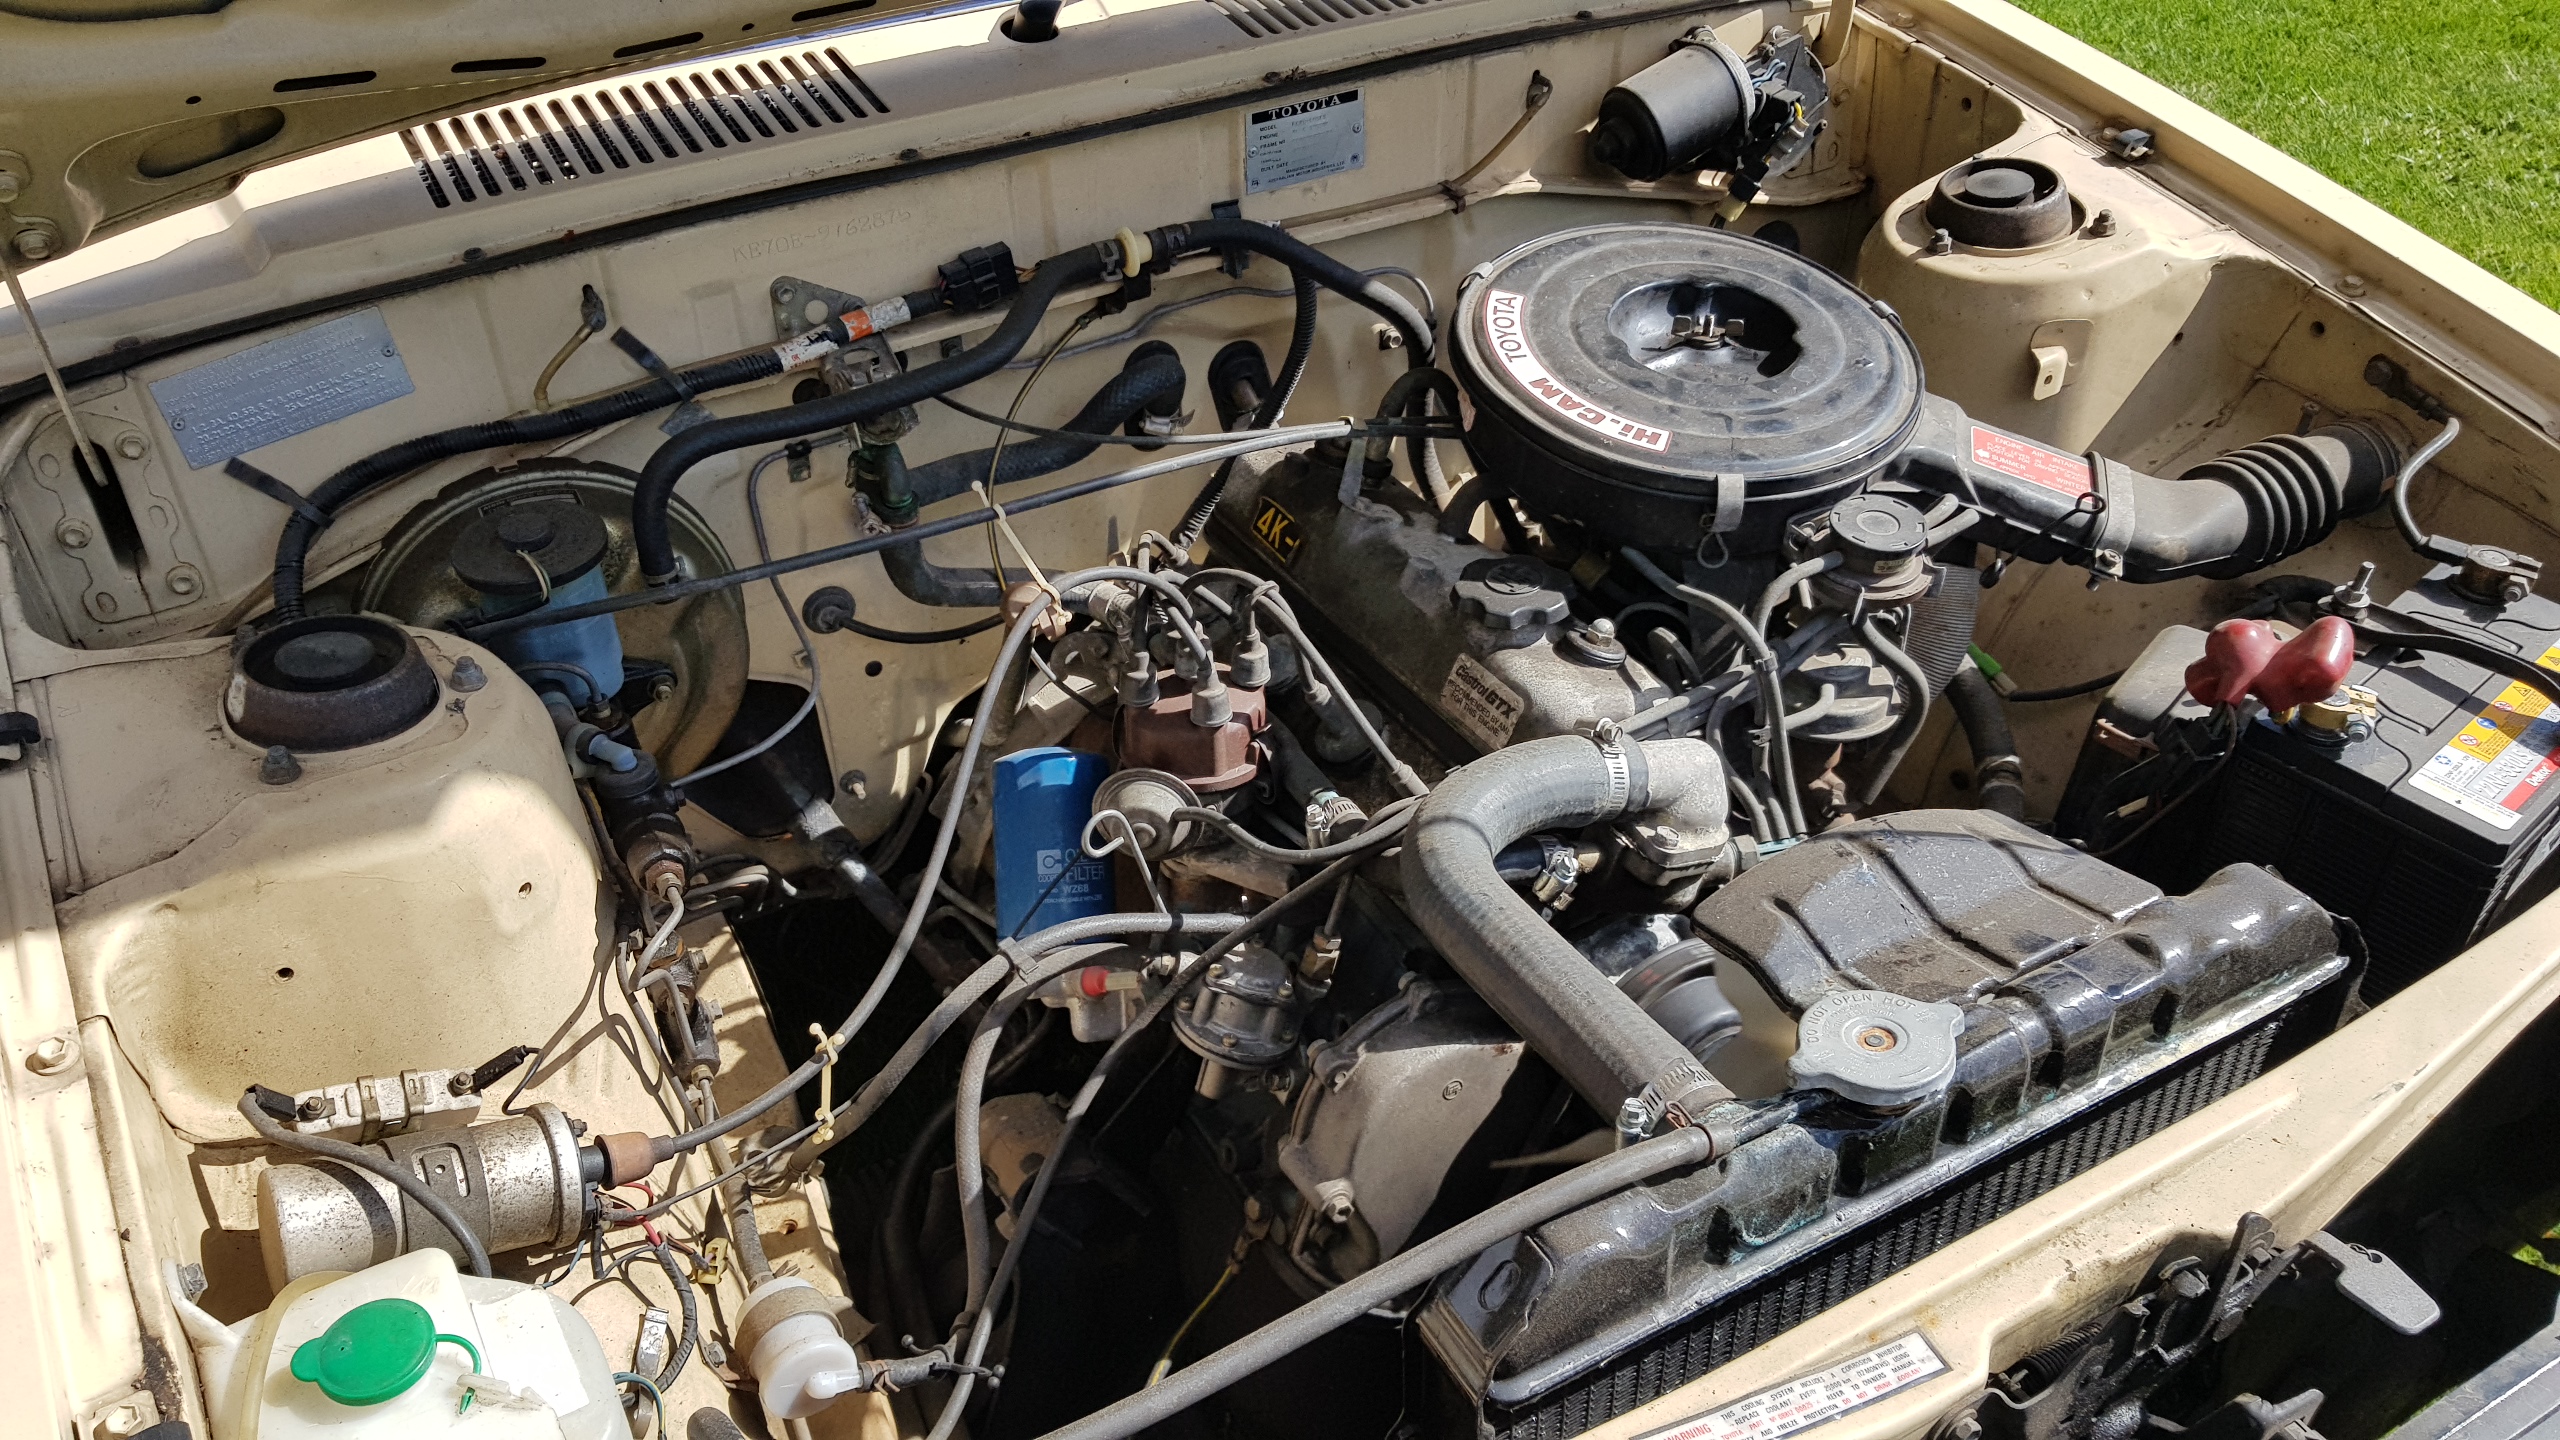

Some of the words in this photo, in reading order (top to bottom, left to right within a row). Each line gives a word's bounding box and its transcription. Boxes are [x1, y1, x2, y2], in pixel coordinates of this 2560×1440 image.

[1269, 95, 1341, 120] TOYOTA
[1492, 296, 1527, 363] TOYOTA
[1991, 454, 2025, 470] SUMMER
[2056, 476, 2085, 491] WINTER
[1995, 436, 2023, 451] ENGINE
[2032, 449, 2044, 458] AIR
[2052, 456, 2078, 470] INTAKE
[1447, 678, 1490, 718] RECOMMENDED
[1490, 714, 1498, 725] BY
[1456, 664, 1488, 698] Castrol
[1486, 688, 1517, 722] GTX
[1450, 691, 1462, 705] FOR
[1463, 702, 1476, 718] THIS
[1477, 715, 1499, 737] ENGINE
[2525, 766, 2551, 787] Delkor
[1808, 1005, 1829, 1027] NOT
[1832, 993, 1874, 1006] OPEN
[1883, 996, 1916, 1009] HOT
[1805, 1028, 1819, 1044] DO
[1720, 1409, 1735, 1421] THIS
[1740, 1398, 1764, 1412] COOLING
[1770, 1385, 1794, 1401] SYSTEM
[1799, 1376, 1825, 1388] INCLUDES
[1840, 1355, 1872, 1374] CORROSION
[1720, 1428, 1743, 1440] TOYOTA
[1748, 1419, 1763, 1430] PART
[1826, 1388, 1845, 1401] REFER
[1851, 1382, 1859, 1391] TO
[1861, 1371, 1886, 1386] OWNERS
[1891, 1359, 1916, 1373] MANUAL
[1734, 1409, 1760, 1425] REPLACE
[1765, 1398, 1791, 1414] COOLANT
[1798, 1387, 1816, 1400] EVERY
[1841, 1376, 1851, 1384] km
[1892, 1350, 1910, 1362] USING
[1760, 1428, 1774, 1437] AND
[1777, 1420, 1799, 1432] FREEZE
[1842, 1396, 1851, 1405] DO
[1856, 1390, 1868, 1400] NOT
[1873, 1379, 1892, 1392] DRINK
[1896, 1366, 1922, 1382] COOLANT
